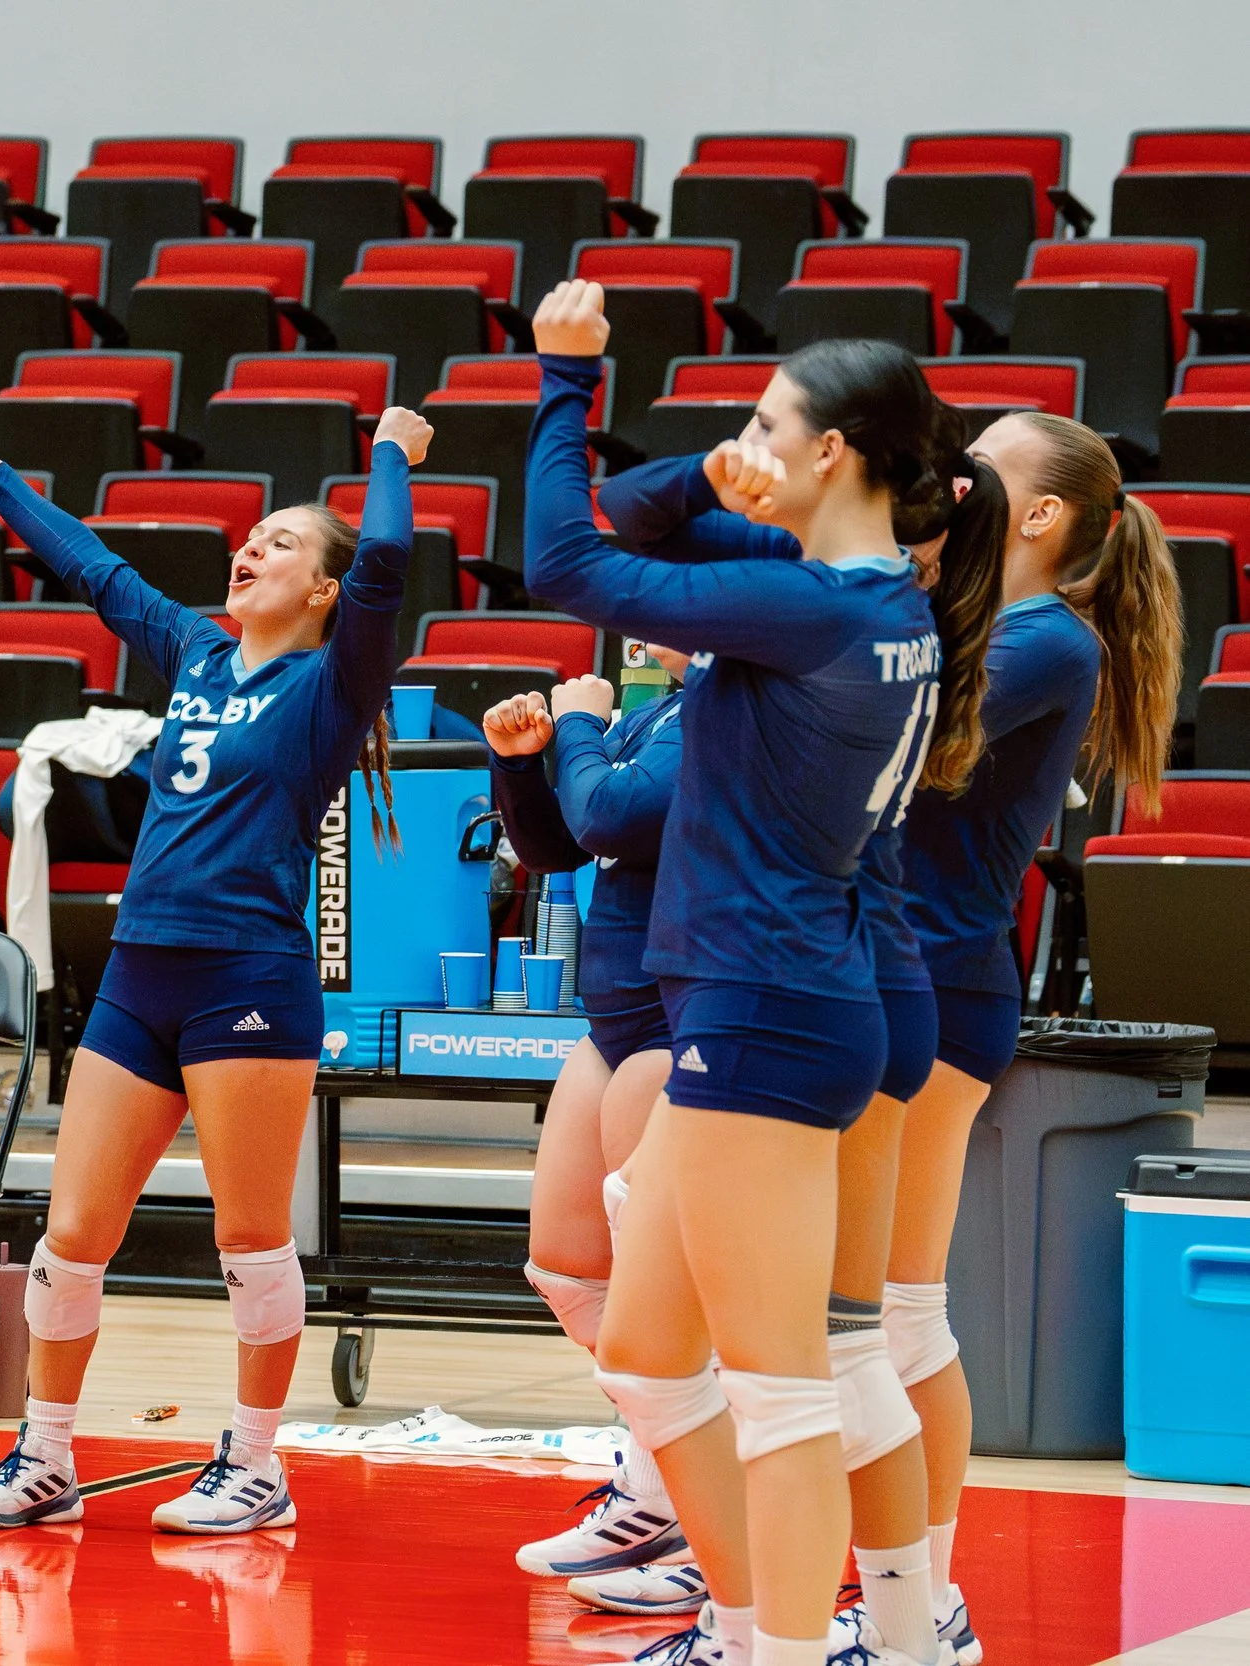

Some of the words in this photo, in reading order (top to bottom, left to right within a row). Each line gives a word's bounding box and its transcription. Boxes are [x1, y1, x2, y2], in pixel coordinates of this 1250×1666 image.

[166, 691, 278, 724] COLBY
[171, 728, 219, 795] 3
[232, 1023, 270, 1032] adidas
[408, 1033, 578, 1060] POWERADE
